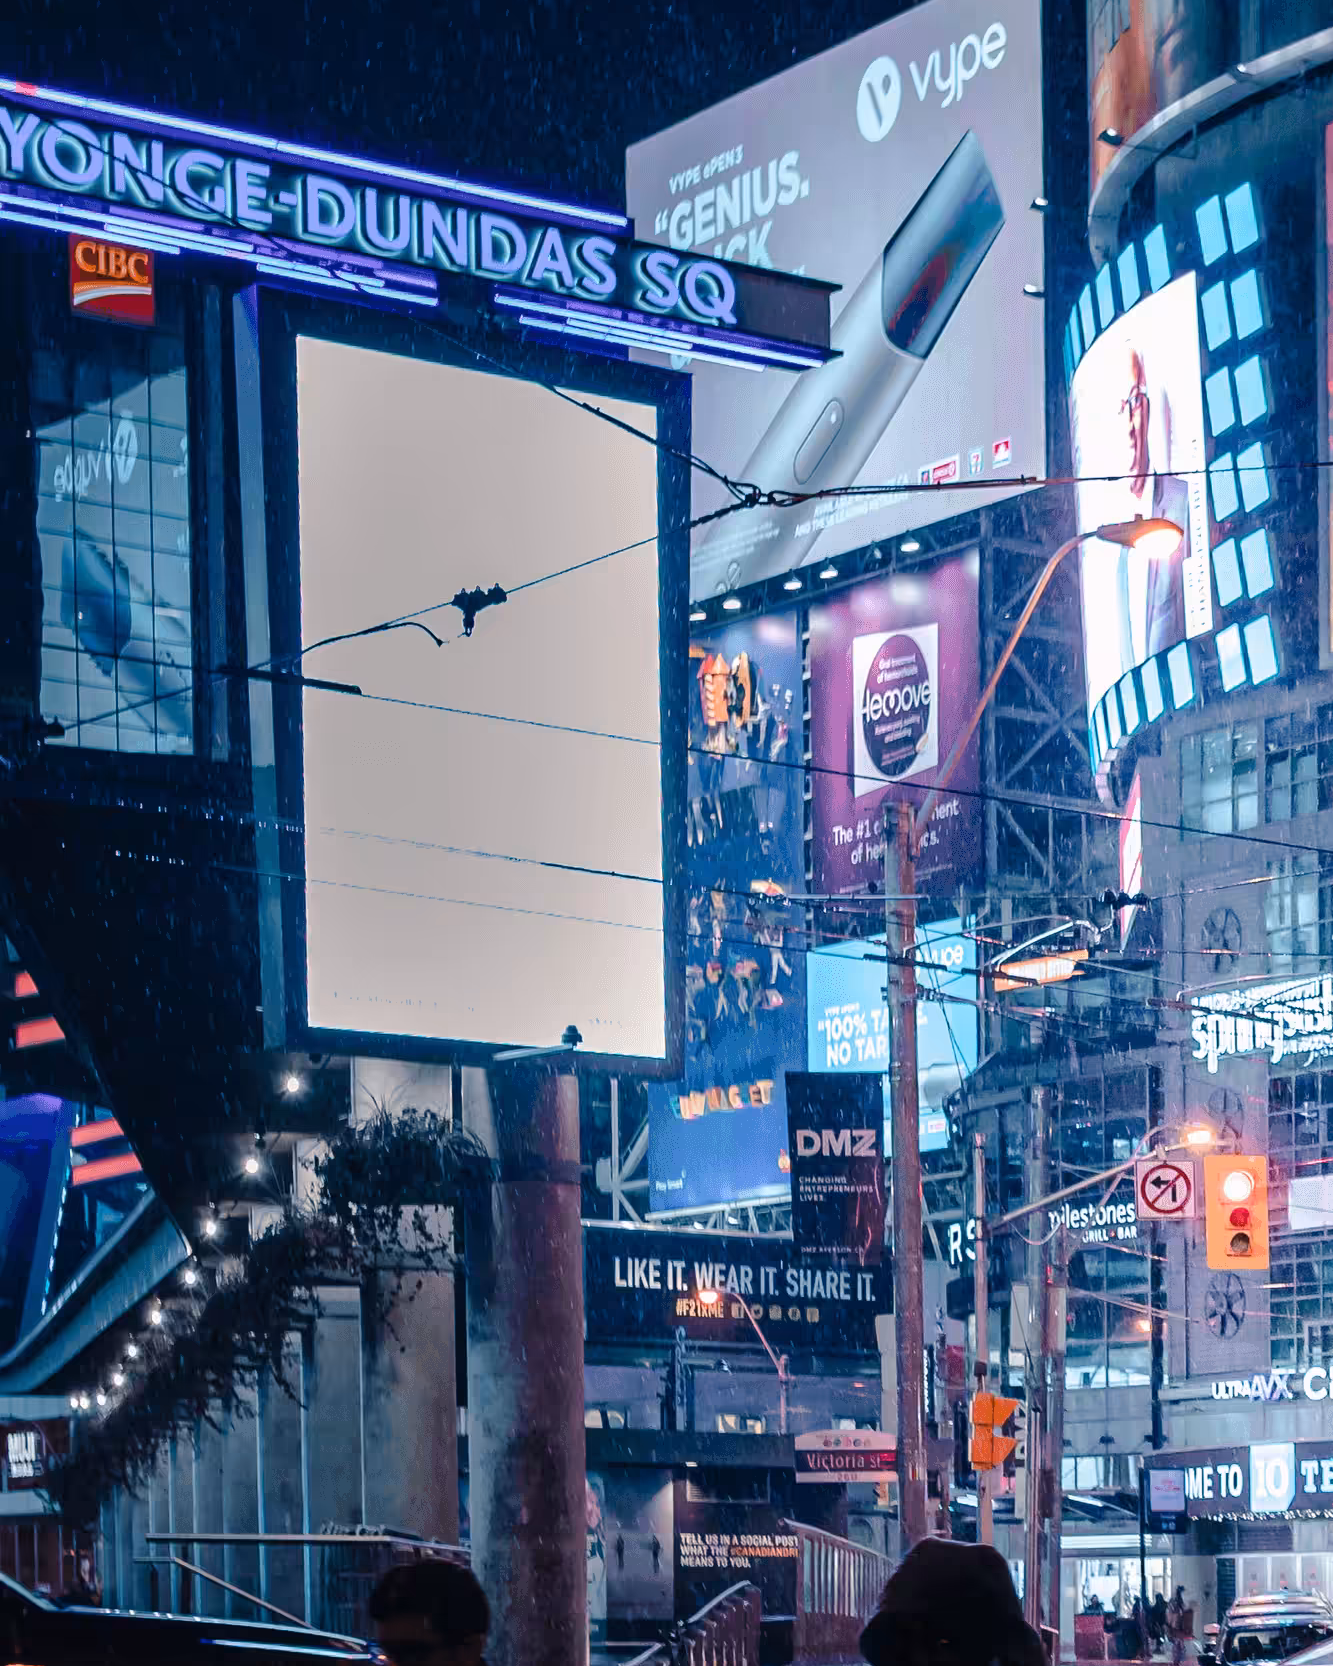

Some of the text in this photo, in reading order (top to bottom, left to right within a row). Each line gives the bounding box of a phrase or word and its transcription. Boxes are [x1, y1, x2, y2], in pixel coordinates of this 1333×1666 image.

[909, 22, 1007, 108] vype
[669, 164, 700, 195] VYPE
[74, 239, 150, 286] CIBC
[637, 250, 737, 325] SQ
[832, 825, 853, 846] The
[856, 819, 872, 839] #1
[851, 844, 864, 865] of
[827, 1044, 851, 1067] NO
[796, 1129, 876, 1157] DMZ
[614, 1256, 876, 1302] LIKE IT. WEAR IT. SHARE IT.
[807, 1452, 865, 1470] Victoria
[1217, 1463, 1243, 1498] TO
[680, 1533, 704, 1545] TELL
[706, 1534, 718, 1546] US
[720, 1535, 730, 1546] IN
[732, 1535, 739, 1546] A
[741, 1535, 773, 1547] SOCIAL
[680, 1544, 708, 1556] WHAT
[710, 1545, 728, 1556] THE
[680, 1555, 714, 1567] MEANS
[715, 1556, 728, 1567] TO
